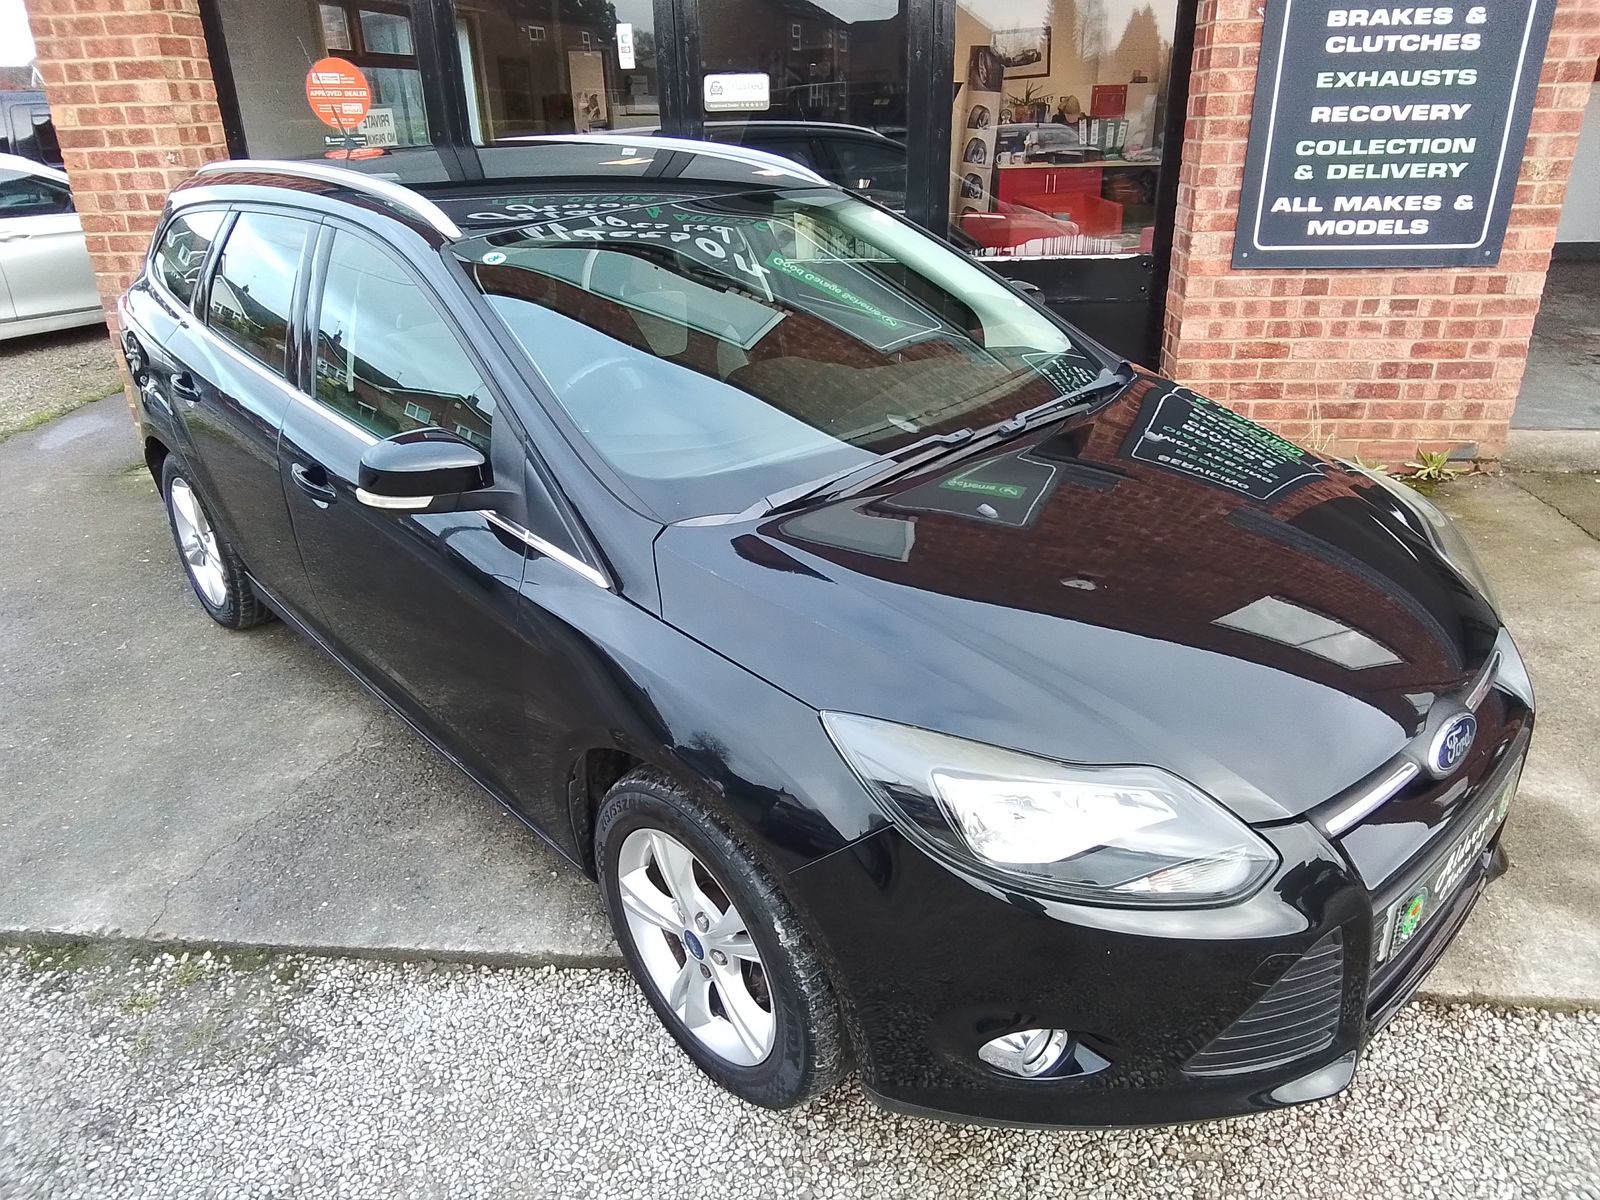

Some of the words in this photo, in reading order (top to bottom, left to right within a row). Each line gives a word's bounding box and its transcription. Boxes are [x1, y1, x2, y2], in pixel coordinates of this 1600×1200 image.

[1326, 7, 1454, 27] BRAKES
[1465, 6, 1487, 25] &
[1325, 33, 1482, 53] CLUTCHES
[1315, 68, 1478, 89] EXHAUSTS
[1310, 103, 1472, 124] RECOVERY
[1295, 137, 1477, 157] COLLECTION
[1293, 164, 1314, 180] &
[1326, 161, 1469, 180] DELIVERY
[1270, 196, 1323, 213] ALL
[1333, 194, 1442, 212] MAKES
[1453, 195, 1474, 211] &
[1306, 218, 1430, 237] MODELS
[1446, 725, 1472, 764] Ford
